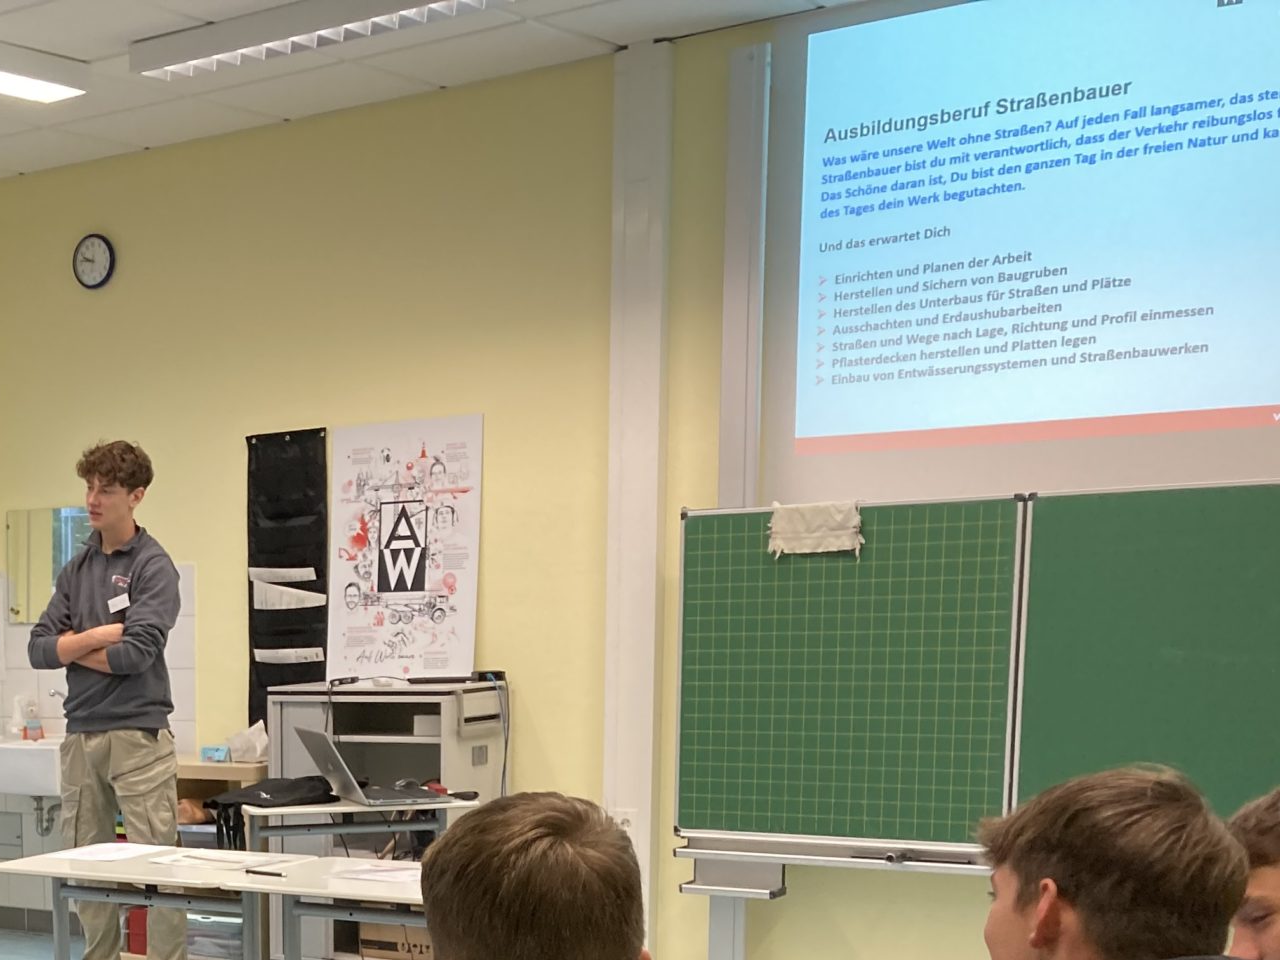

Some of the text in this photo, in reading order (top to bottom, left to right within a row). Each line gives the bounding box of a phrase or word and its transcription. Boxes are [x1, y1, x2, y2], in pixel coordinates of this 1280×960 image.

[822, 90, 1280, 167] Was wäre unsere Welt ohne Straßen? Auf jeden Fall langsamer, das ste
[824, 80, 1132, 143] Ausbildungsberuf Straßenbauer
[821, 164, 901, 184] Straßenbauer
[905, 160, 926, 172] bist
[930, 156, 945, 167] du
[949, 152, 970, 165] mit
[974, 136, 1071, 162] verantwortlich,
[1076, 133, 1105, 146] dass
[1109, 129, 1131, 141] der
[1136, 121, 1188, 137] Verkehr
[1192, 110, 1273, 129] reibungslos
[821, 191, 841, 202] Das
[845, 184, 887, 198] Schöne
[891, 178, 925, 191] daran
[929, 174, 946, 186] ist,
[951, 171, 967, 182] Du
[972, 166, 994, 179] bist
[998, 163, 1021, 176] den
[1025, 157, 1070, 174] ganzen
[1074, 153, 1096, 165] Tag
[1101, 149, 1112, 161] in
[1117, 147, 1139, 159] der
[1143, 140, 1183, 155] freien
[1188, 136, 1228, 149] Natur
[1232, 128, 1259, 143] und
[820, 181, 1025, 219] des Tages dein Werk begutachten.
[819, 226, 951, 253] Und das erwartet Dich
[834, 266, 1067, 301] Herstellen und Sichern von Baugruben
[835, 251, 1032, 285] Einrichten und Planen der Arbeit
[833, 276, 1132, 318] Herstellen des Unterbaus für Straßen und Plätze
[832, 306, 1214, 351] Straßen und Wege nach Lage, Richtung und Profil einmessen
[833, 303, 1062, 335] Ausschachten und Erdaushubarbeiten
[831, 343, 1209, 385] Einbau von Entwässerungssystemen und Straßenbauwerken
[832, 335, 1096, 368] Pflasterdecken herstellen und Platten legen
